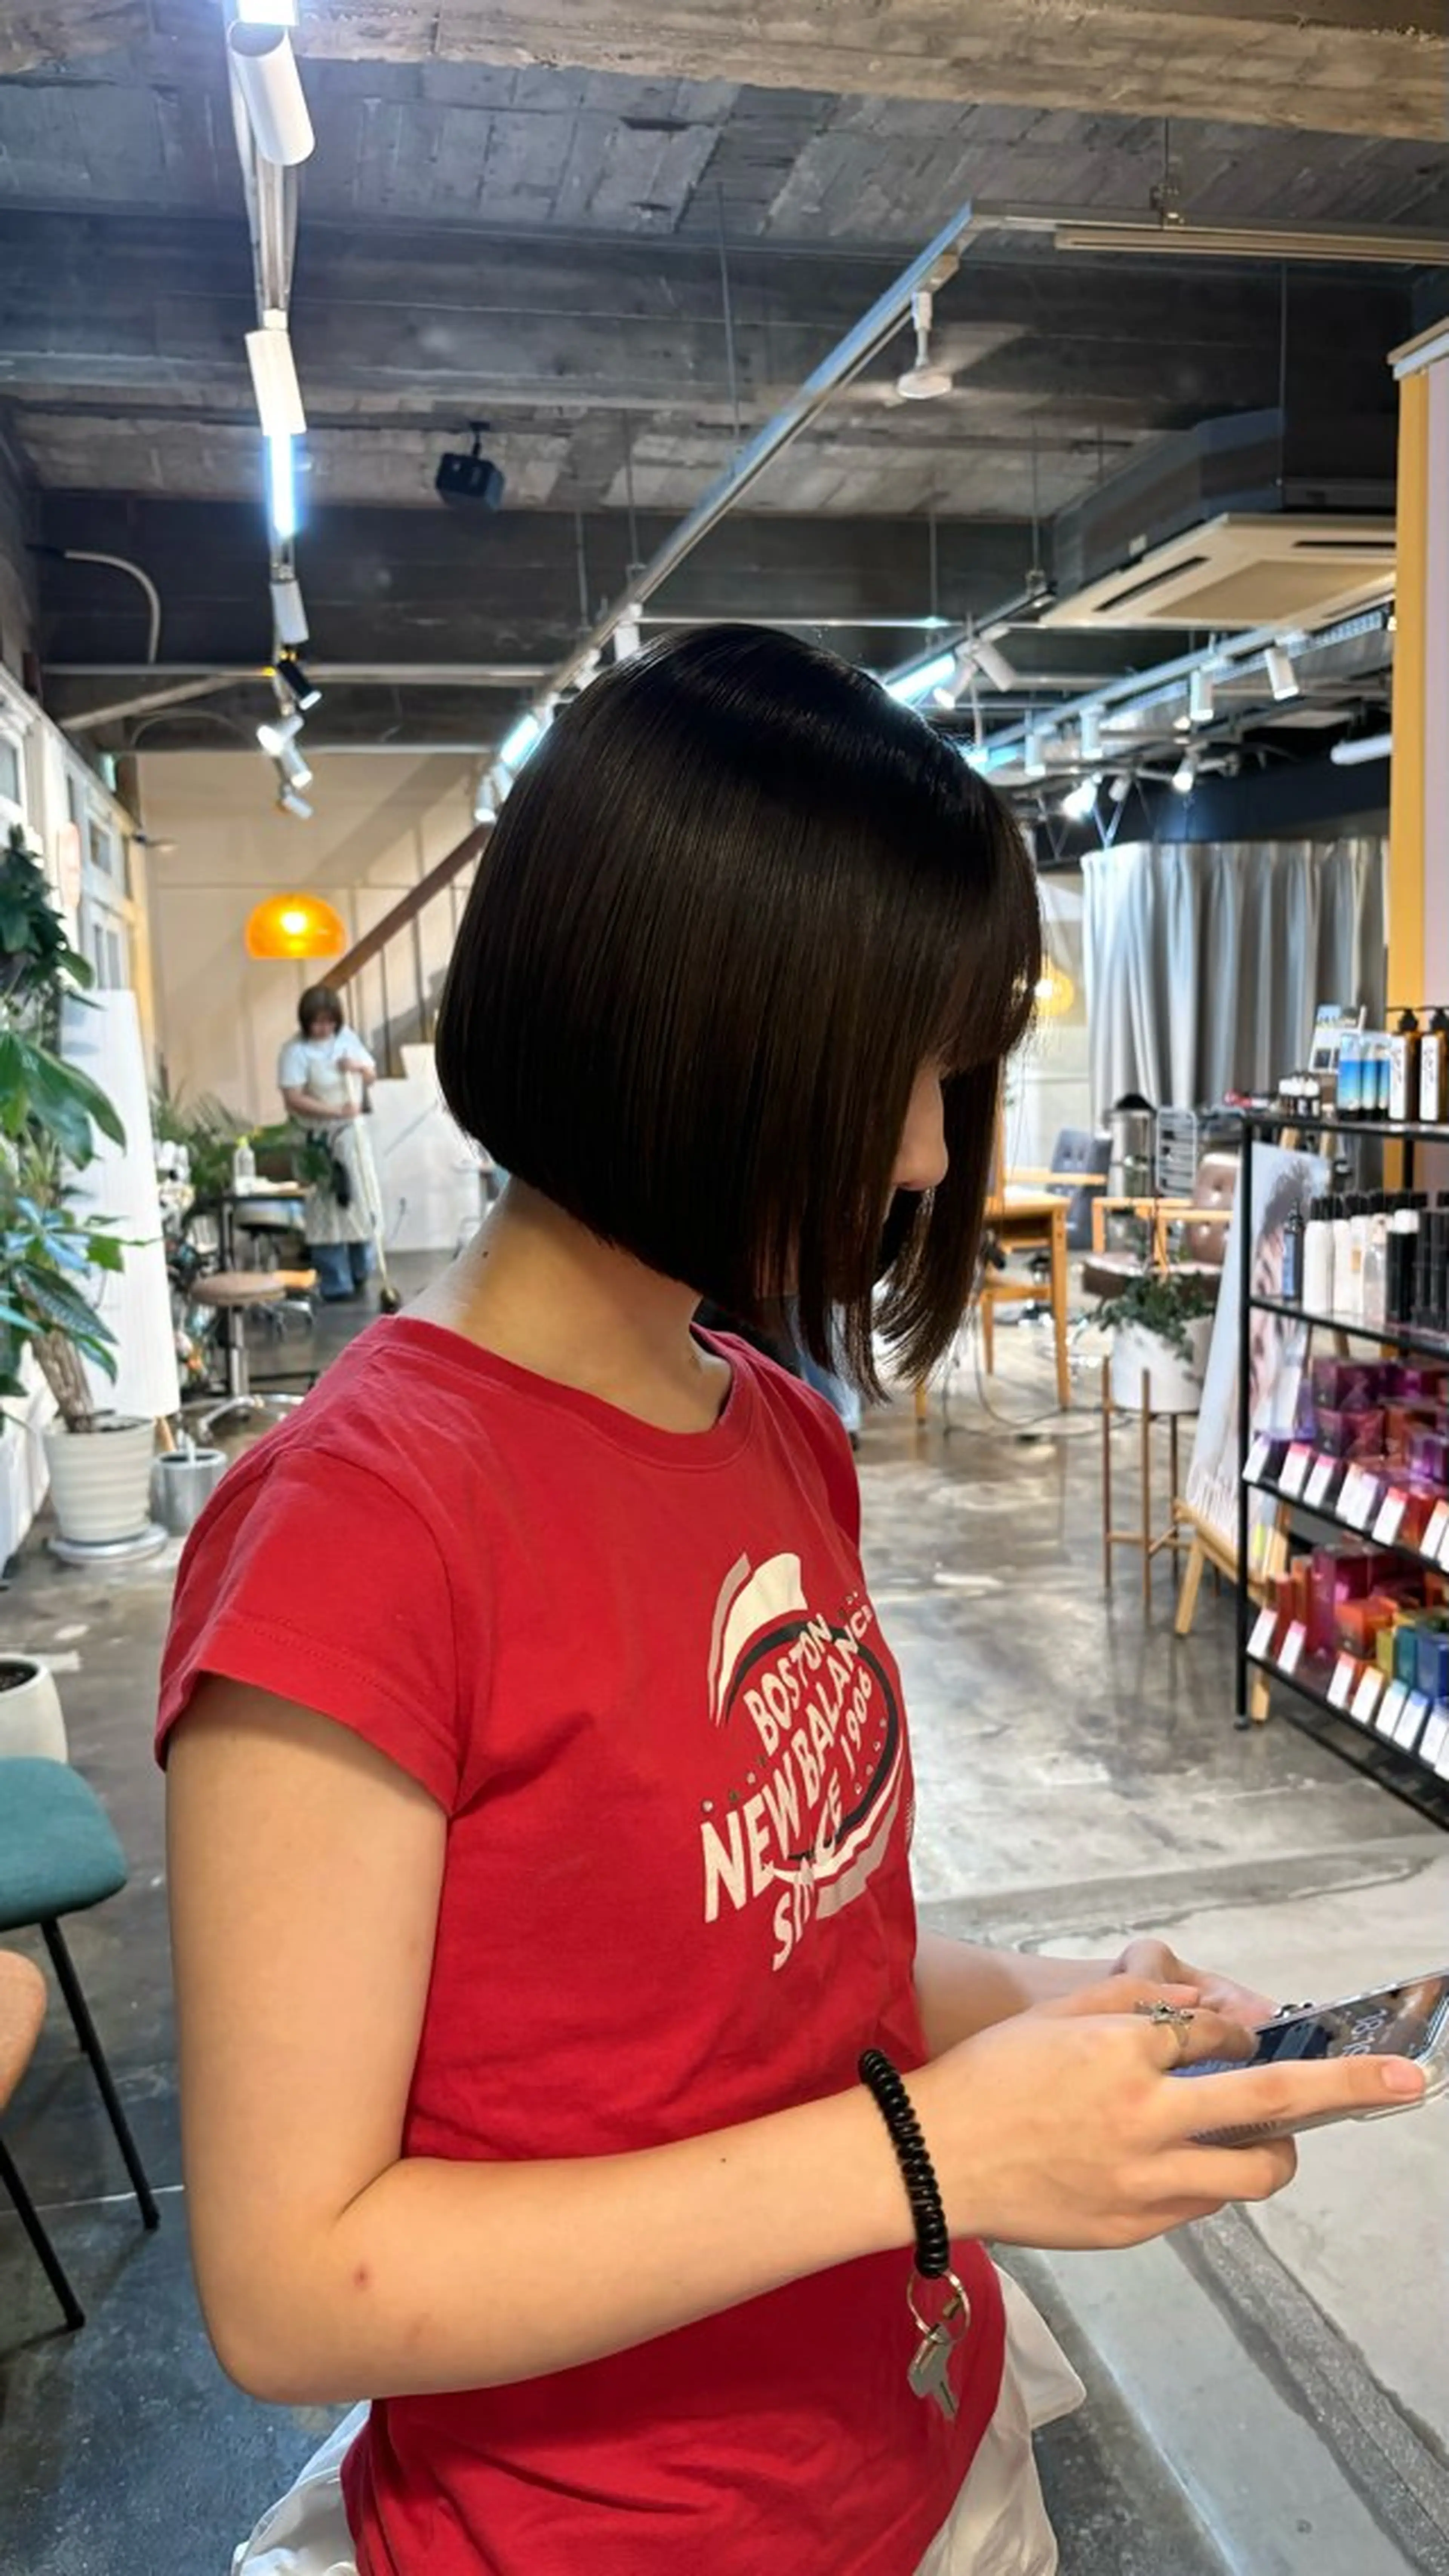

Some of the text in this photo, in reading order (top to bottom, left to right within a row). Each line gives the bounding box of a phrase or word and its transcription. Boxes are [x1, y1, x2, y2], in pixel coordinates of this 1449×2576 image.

[744, 1612, 832, 1756] BOSTON
[840, 1666, 872, 1775] 1906
[700, 1751, 800, 1922] NEW
